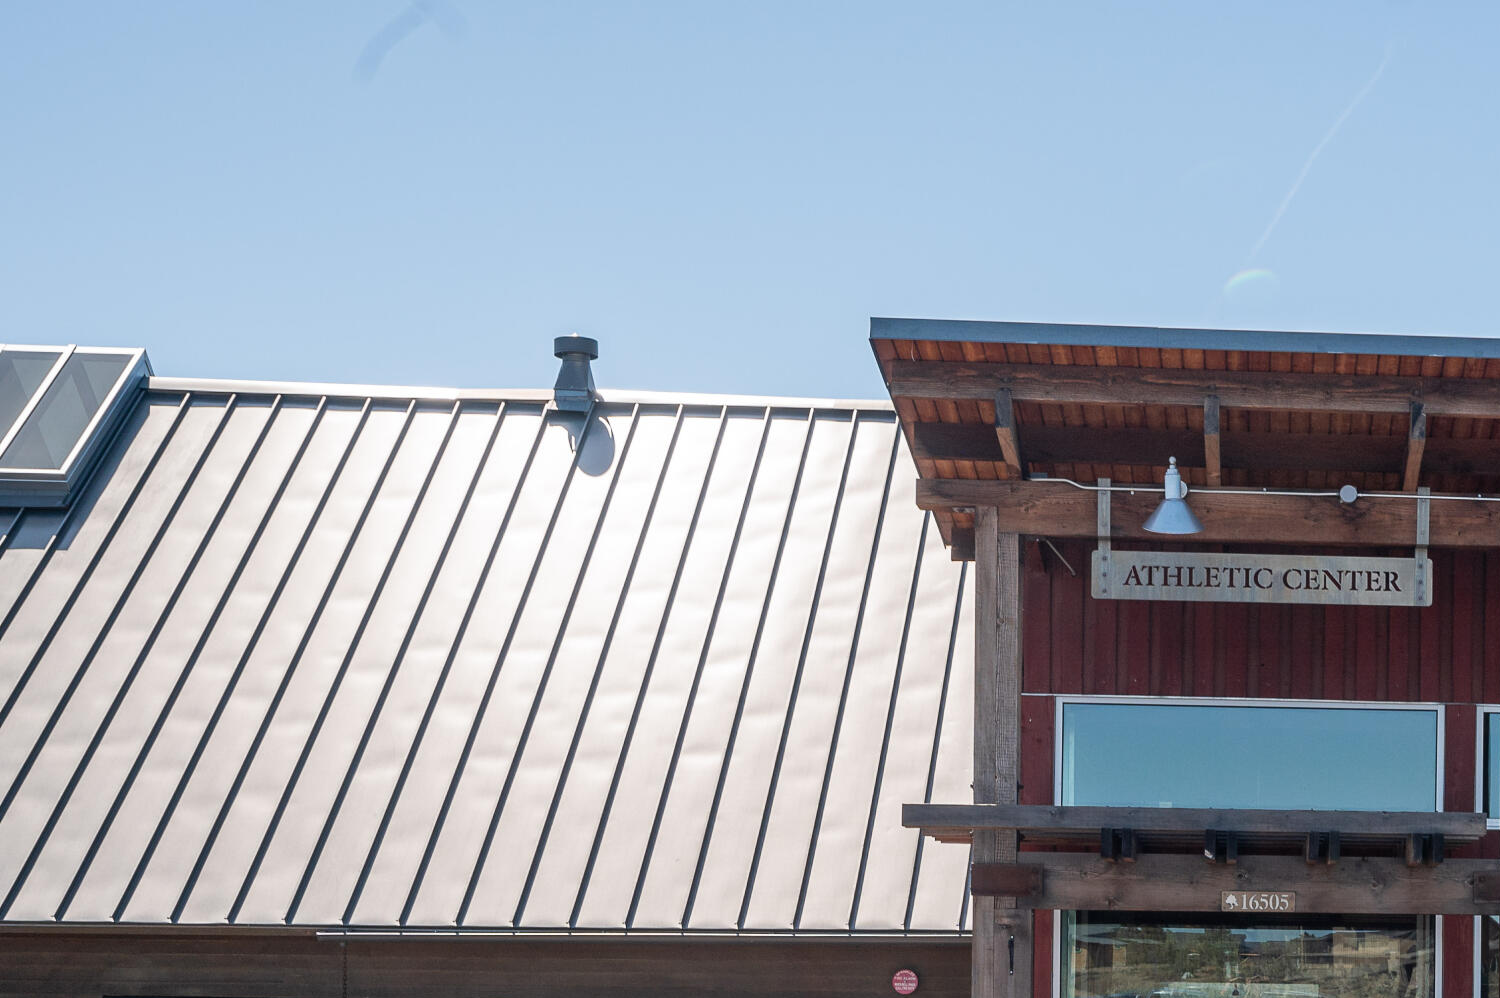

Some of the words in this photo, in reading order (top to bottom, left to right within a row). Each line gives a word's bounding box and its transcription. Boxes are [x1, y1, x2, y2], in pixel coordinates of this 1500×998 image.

[1123, 565, 1273, 590] ATHLETIC
[1282, 568, 1402, 592] CENTER
[1240, 894, 1289, 910] 16505
